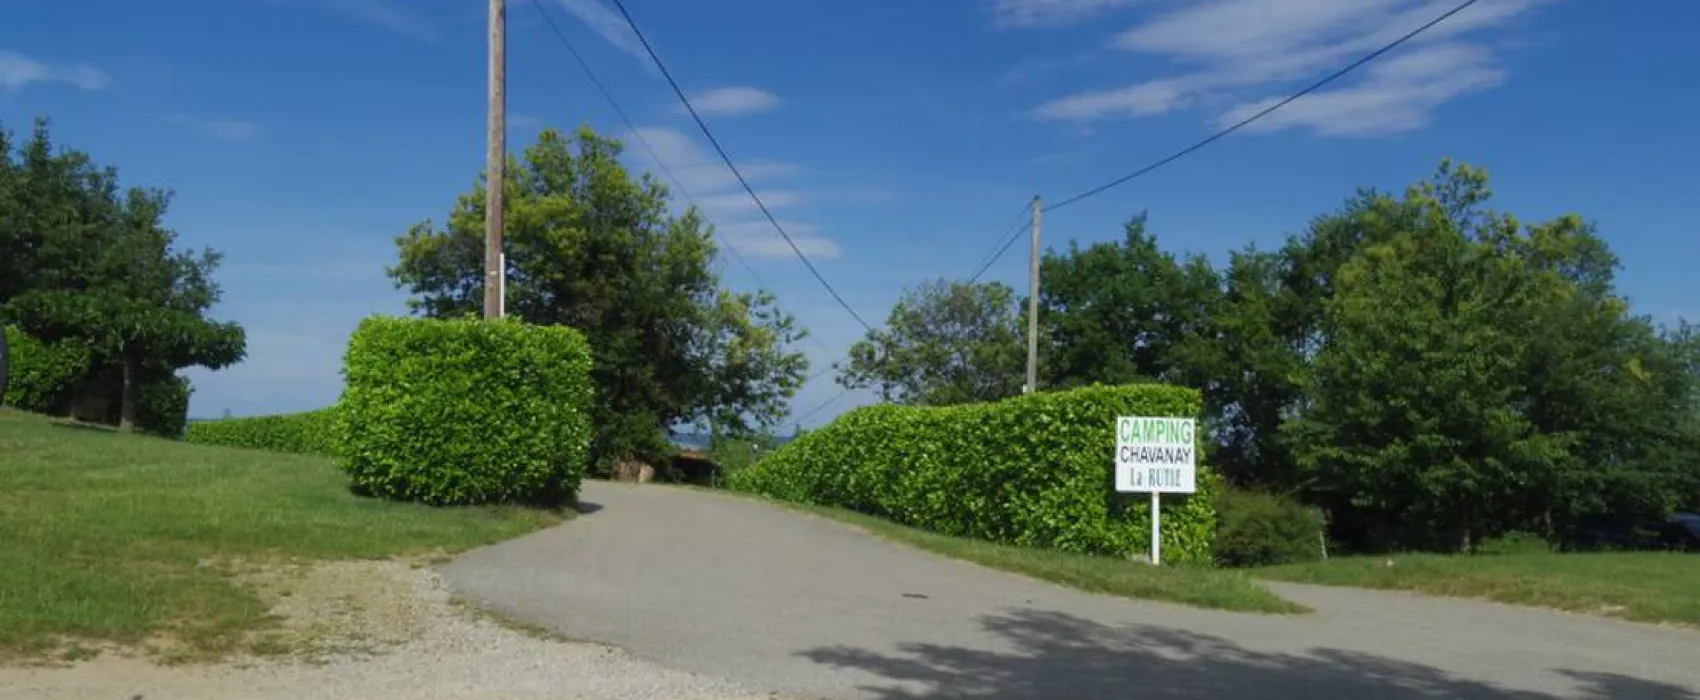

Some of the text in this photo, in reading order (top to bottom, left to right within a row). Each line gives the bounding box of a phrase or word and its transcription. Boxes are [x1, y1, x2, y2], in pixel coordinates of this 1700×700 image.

[1120, 419, 1192, 444] CAMPING
[1120, 446, 1191, 464] CHAVANAY
[1130, 467, 1143, 487] La
